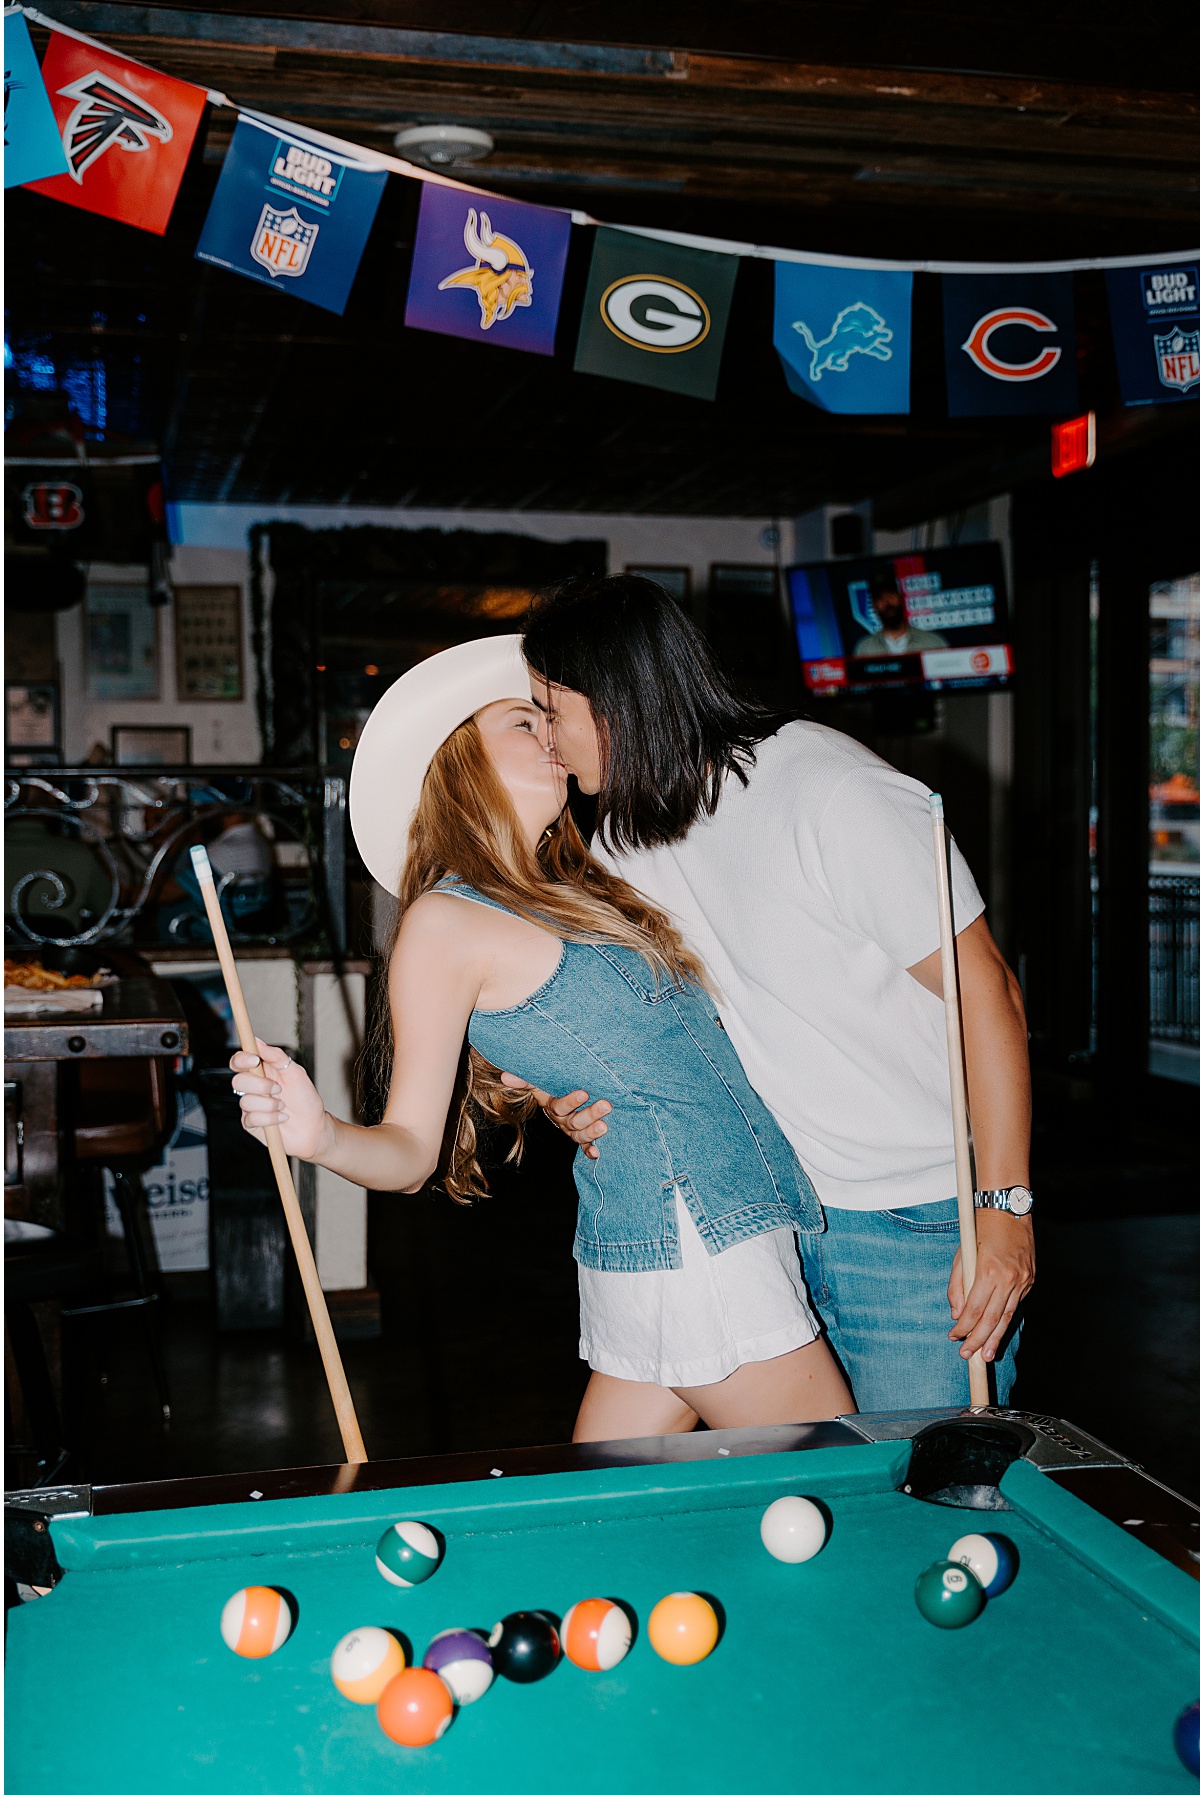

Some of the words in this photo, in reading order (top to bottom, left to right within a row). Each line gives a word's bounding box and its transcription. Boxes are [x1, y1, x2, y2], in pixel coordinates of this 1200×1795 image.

[286, 146, 332, 177] BUD
[273, 157, 336, 195] LIGHT
[260, 232, 299, 268] NFL
[1146, 285, 1196, 305] LIGHT
[1151, 273, 1188, 291] BUD
[1164, 356, 1199, 381] NFL
